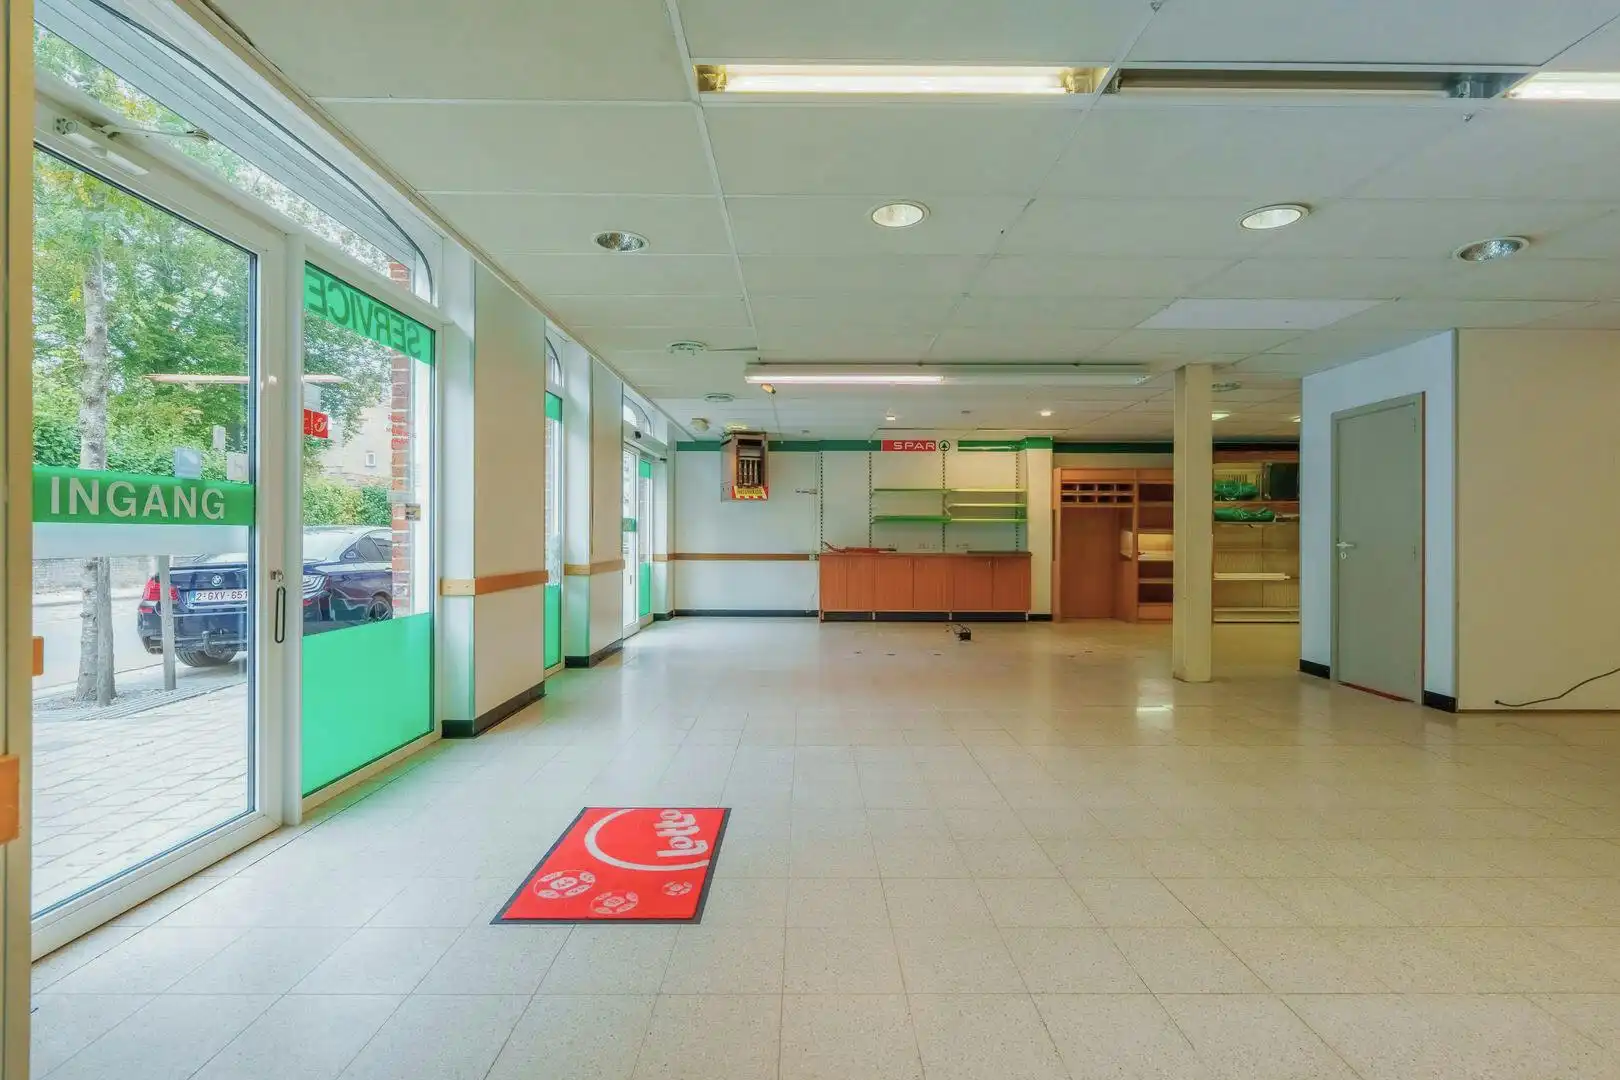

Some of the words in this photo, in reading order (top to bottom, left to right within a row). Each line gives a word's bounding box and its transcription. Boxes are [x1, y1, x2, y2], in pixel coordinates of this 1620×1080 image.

[893, 441, 935, 450] SPAR
[50, 476, 226, 520] INGANG
[653, 809, 708, 857] lotto
